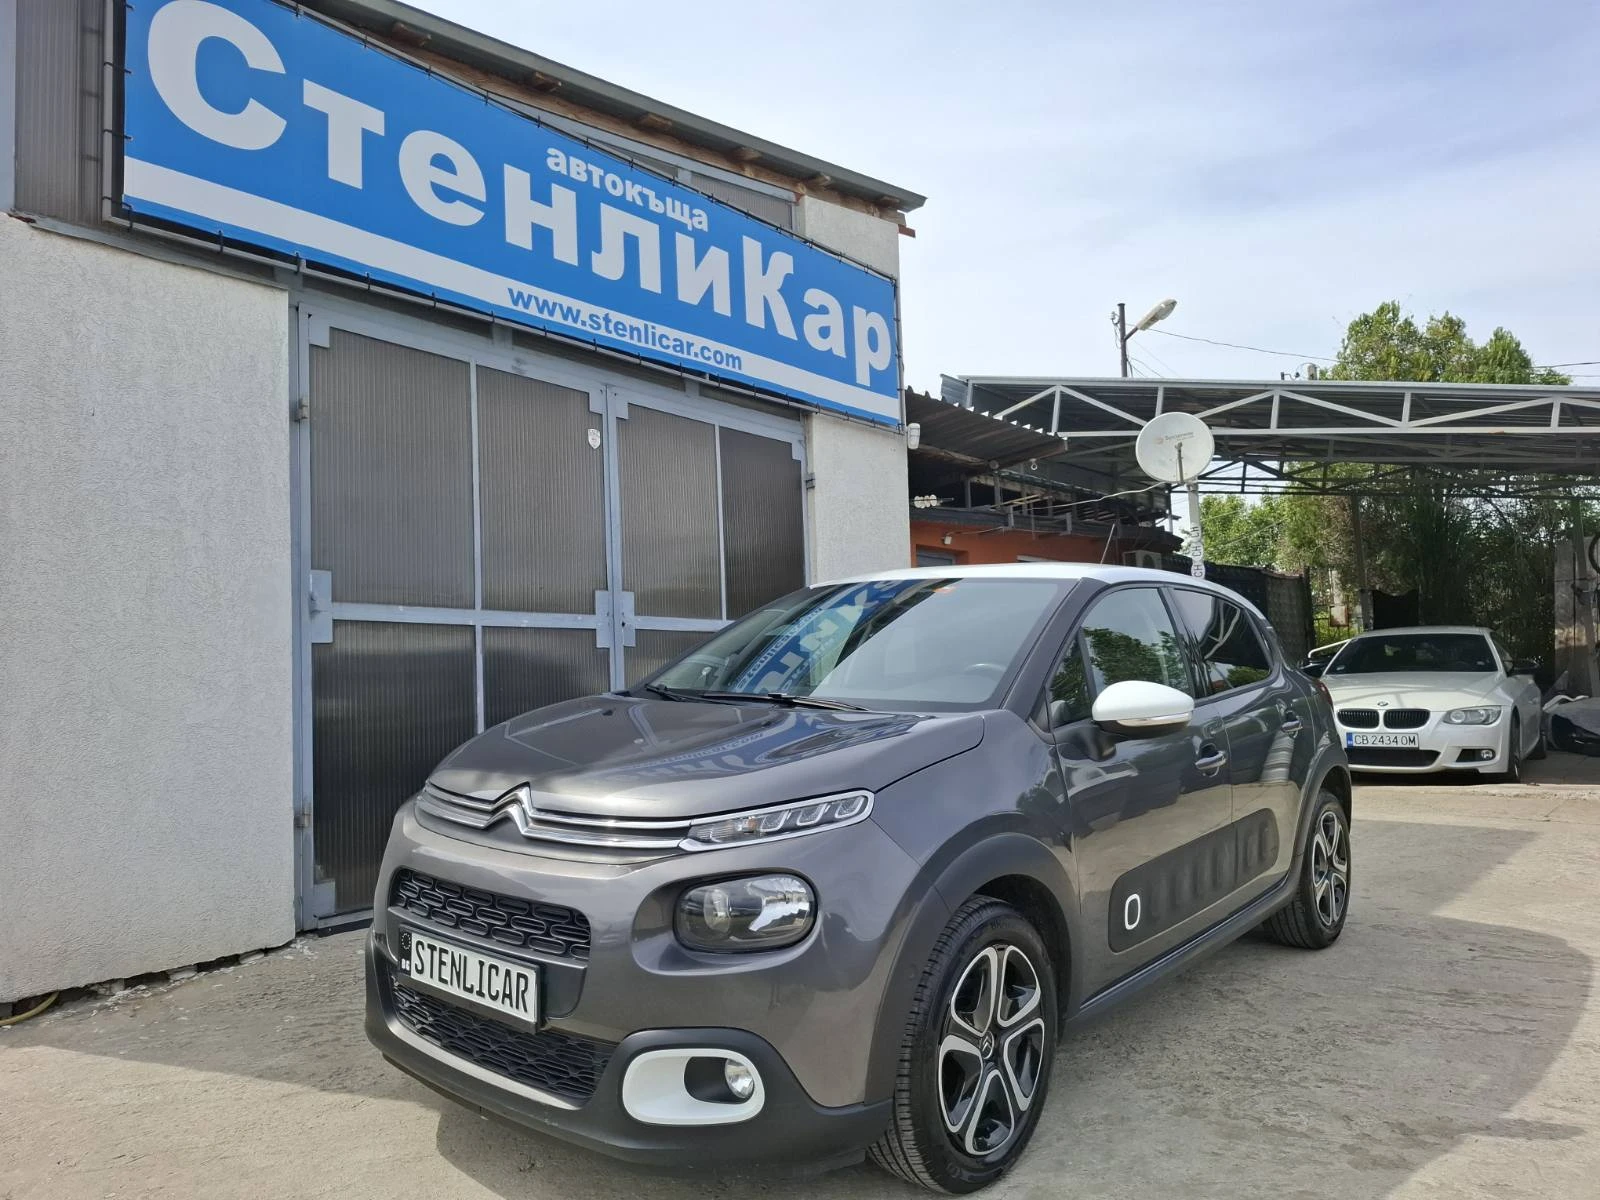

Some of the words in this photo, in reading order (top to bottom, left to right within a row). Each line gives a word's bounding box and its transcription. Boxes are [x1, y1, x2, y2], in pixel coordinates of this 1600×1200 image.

[148, 0, 892, 387] СтенлиКар
[546, 146, 709, 232] автокъща
[507, 286, 743, 371] www.stenlicar.com
[1371, 735, 1398, 745] 2434
[414, 940, 529, 1013] STENLICAR
